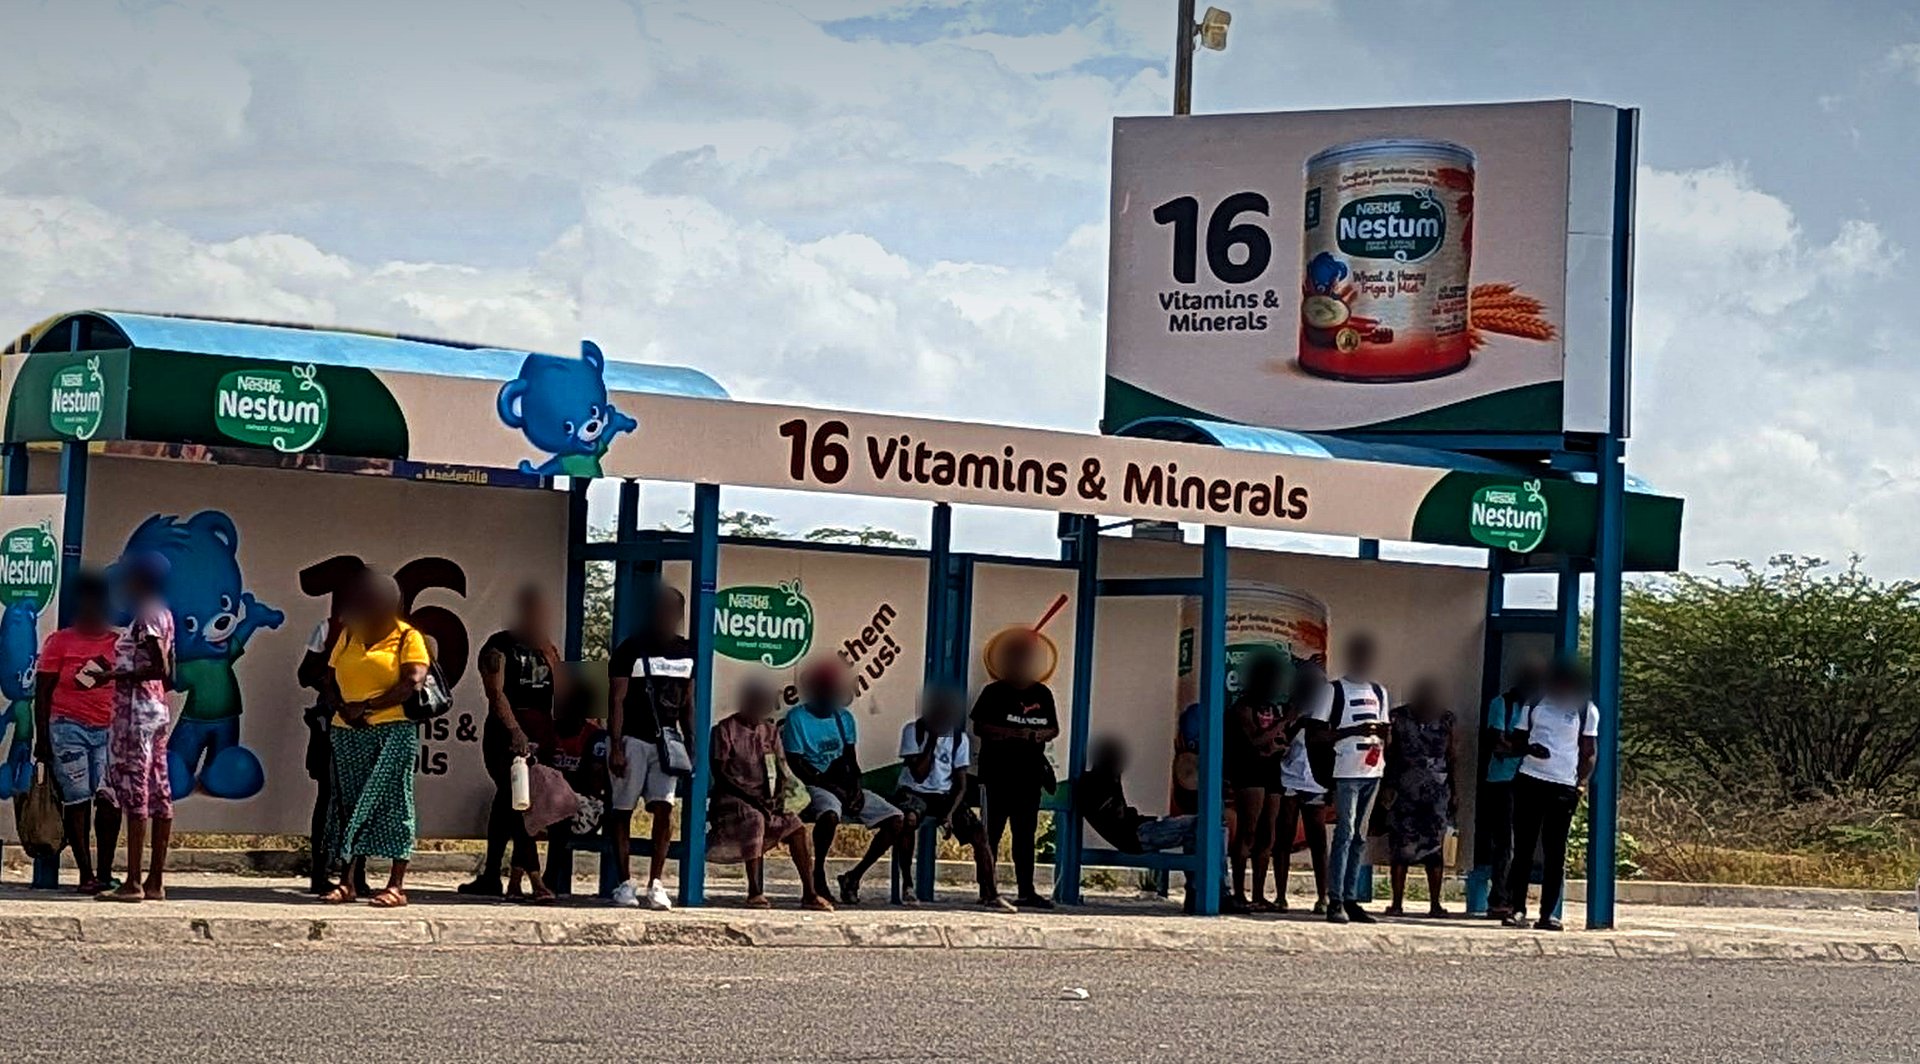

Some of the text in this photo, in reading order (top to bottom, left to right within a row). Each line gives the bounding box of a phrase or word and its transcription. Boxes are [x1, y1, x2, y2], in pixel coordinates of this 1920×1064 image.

[1153, 191, 1272, 284] 16
[1340, 215, 1439, 241] Nestum
[1159, 289, 1279, 311] Vitamins &
[1169, 311, 1268, 332] Minerals
[52, 387, 100, 413] Nestum
[219, 389, 319, 425] Nestum
[778, 418, 1308, 520] 16 Vitamins & Minerals
[1472, 502, 1542, 530] Nestum
[713, 607, 805, 640] Nestum
[455, 713, 478, 742] &
